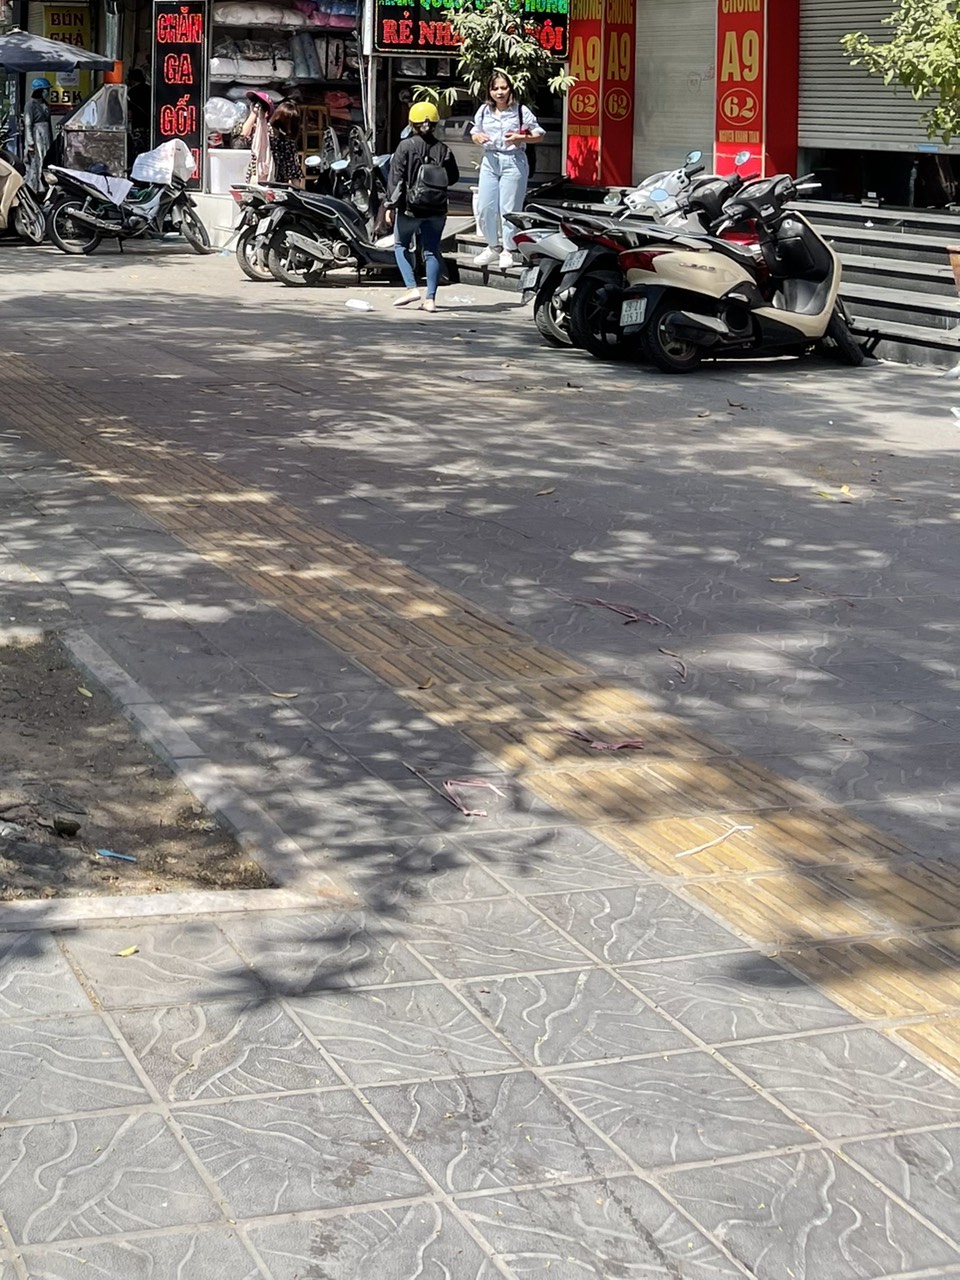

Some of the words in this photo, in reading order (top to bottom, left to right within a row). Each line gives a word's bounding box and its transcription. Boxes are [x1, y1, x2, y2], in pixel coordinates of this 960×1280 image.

[51, 10, 84, 26] BÚN
[157, 6, 202, 44] CHĂN
[382, 10, 414, 45] RẺ
[164, 53, 193, 84] GA
[570, 36, 600, 82] A9
[607, 32, 631, 82] A9
[720, 30, 759, 82] A9
[160, 94, 196, 136] GỐI
[571, 94, 596, 114] 62
[608, 94, 628, 116] 62
[724, 96, 755, 118] 62
